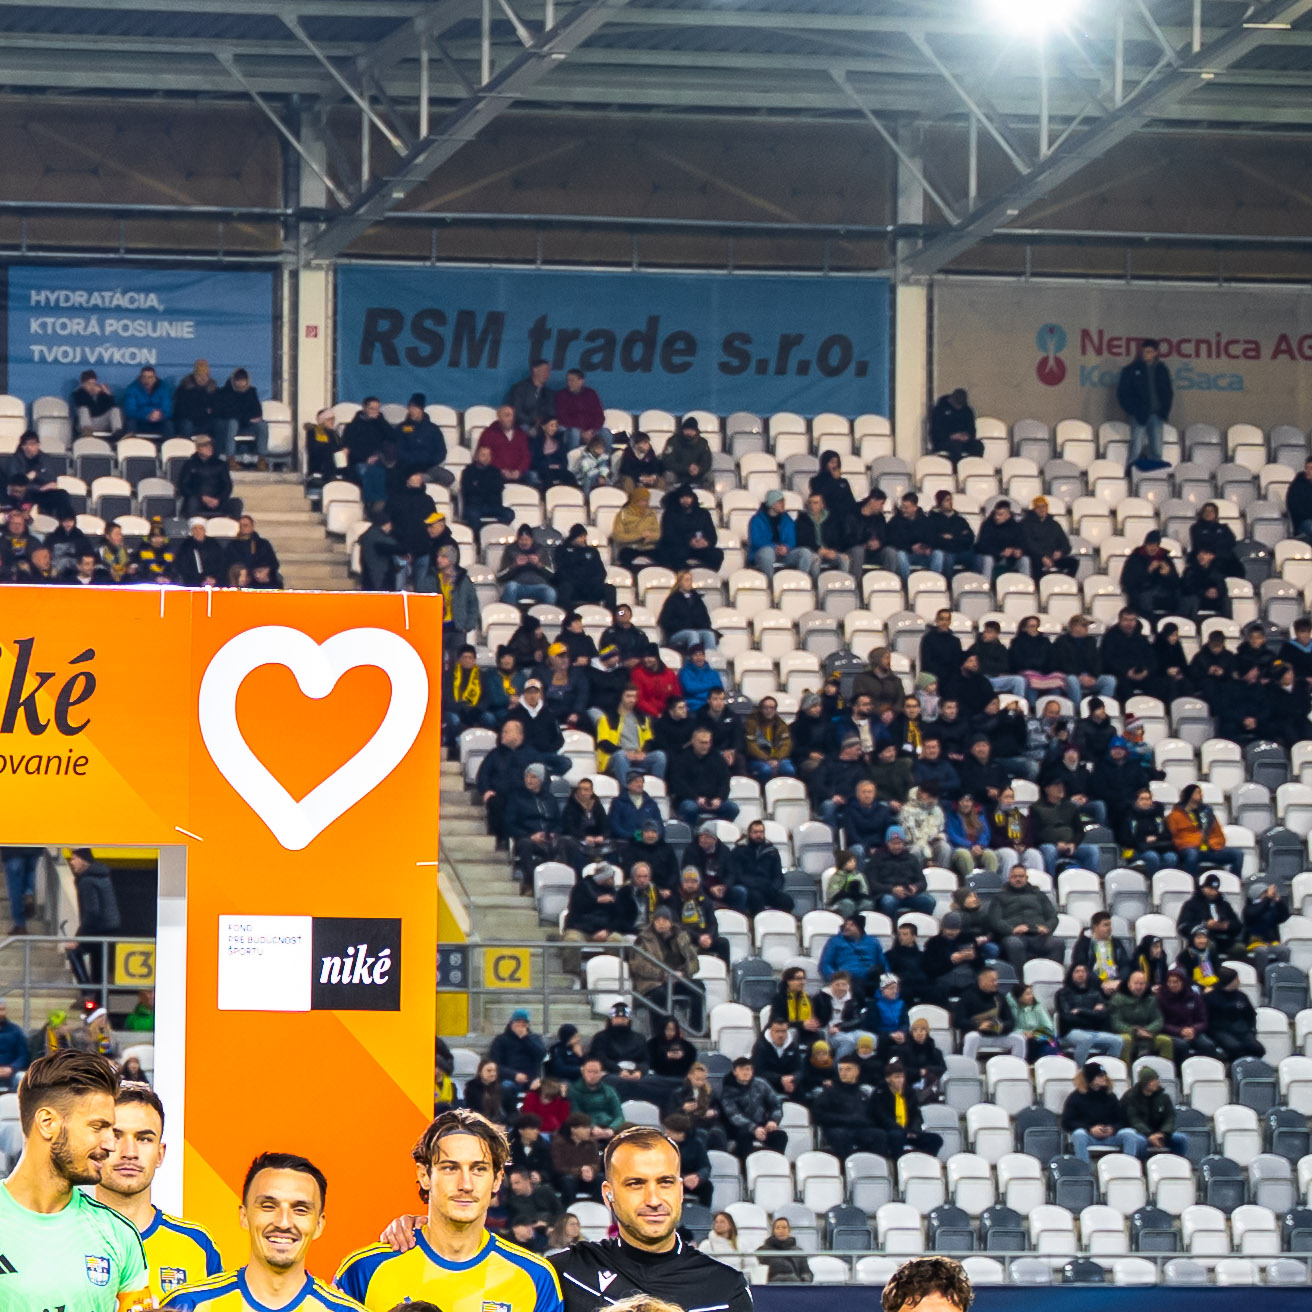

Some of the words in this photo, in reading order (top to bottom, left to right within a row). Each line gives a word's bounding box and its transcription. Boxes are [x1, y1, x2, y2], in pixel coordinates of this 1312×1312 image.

[29, 287, 165, 312] HYDRATÁCIA,
[29, 314, 101, 337] KTORÁ
[105, 319, 196, 339] POSUNIE
[358, 305, 506, 370] RSM
[528, 313, 698, 375] trade
[719, 330, 872, 377] s.r.o.
[29, 345, 81, 364] TVOJ
[85, 343, 158, 365] VÝKON
[123, 950, 153, 979] C3
[319, 943, 392, 985] niké
[492, 954, 522, 983] C2
